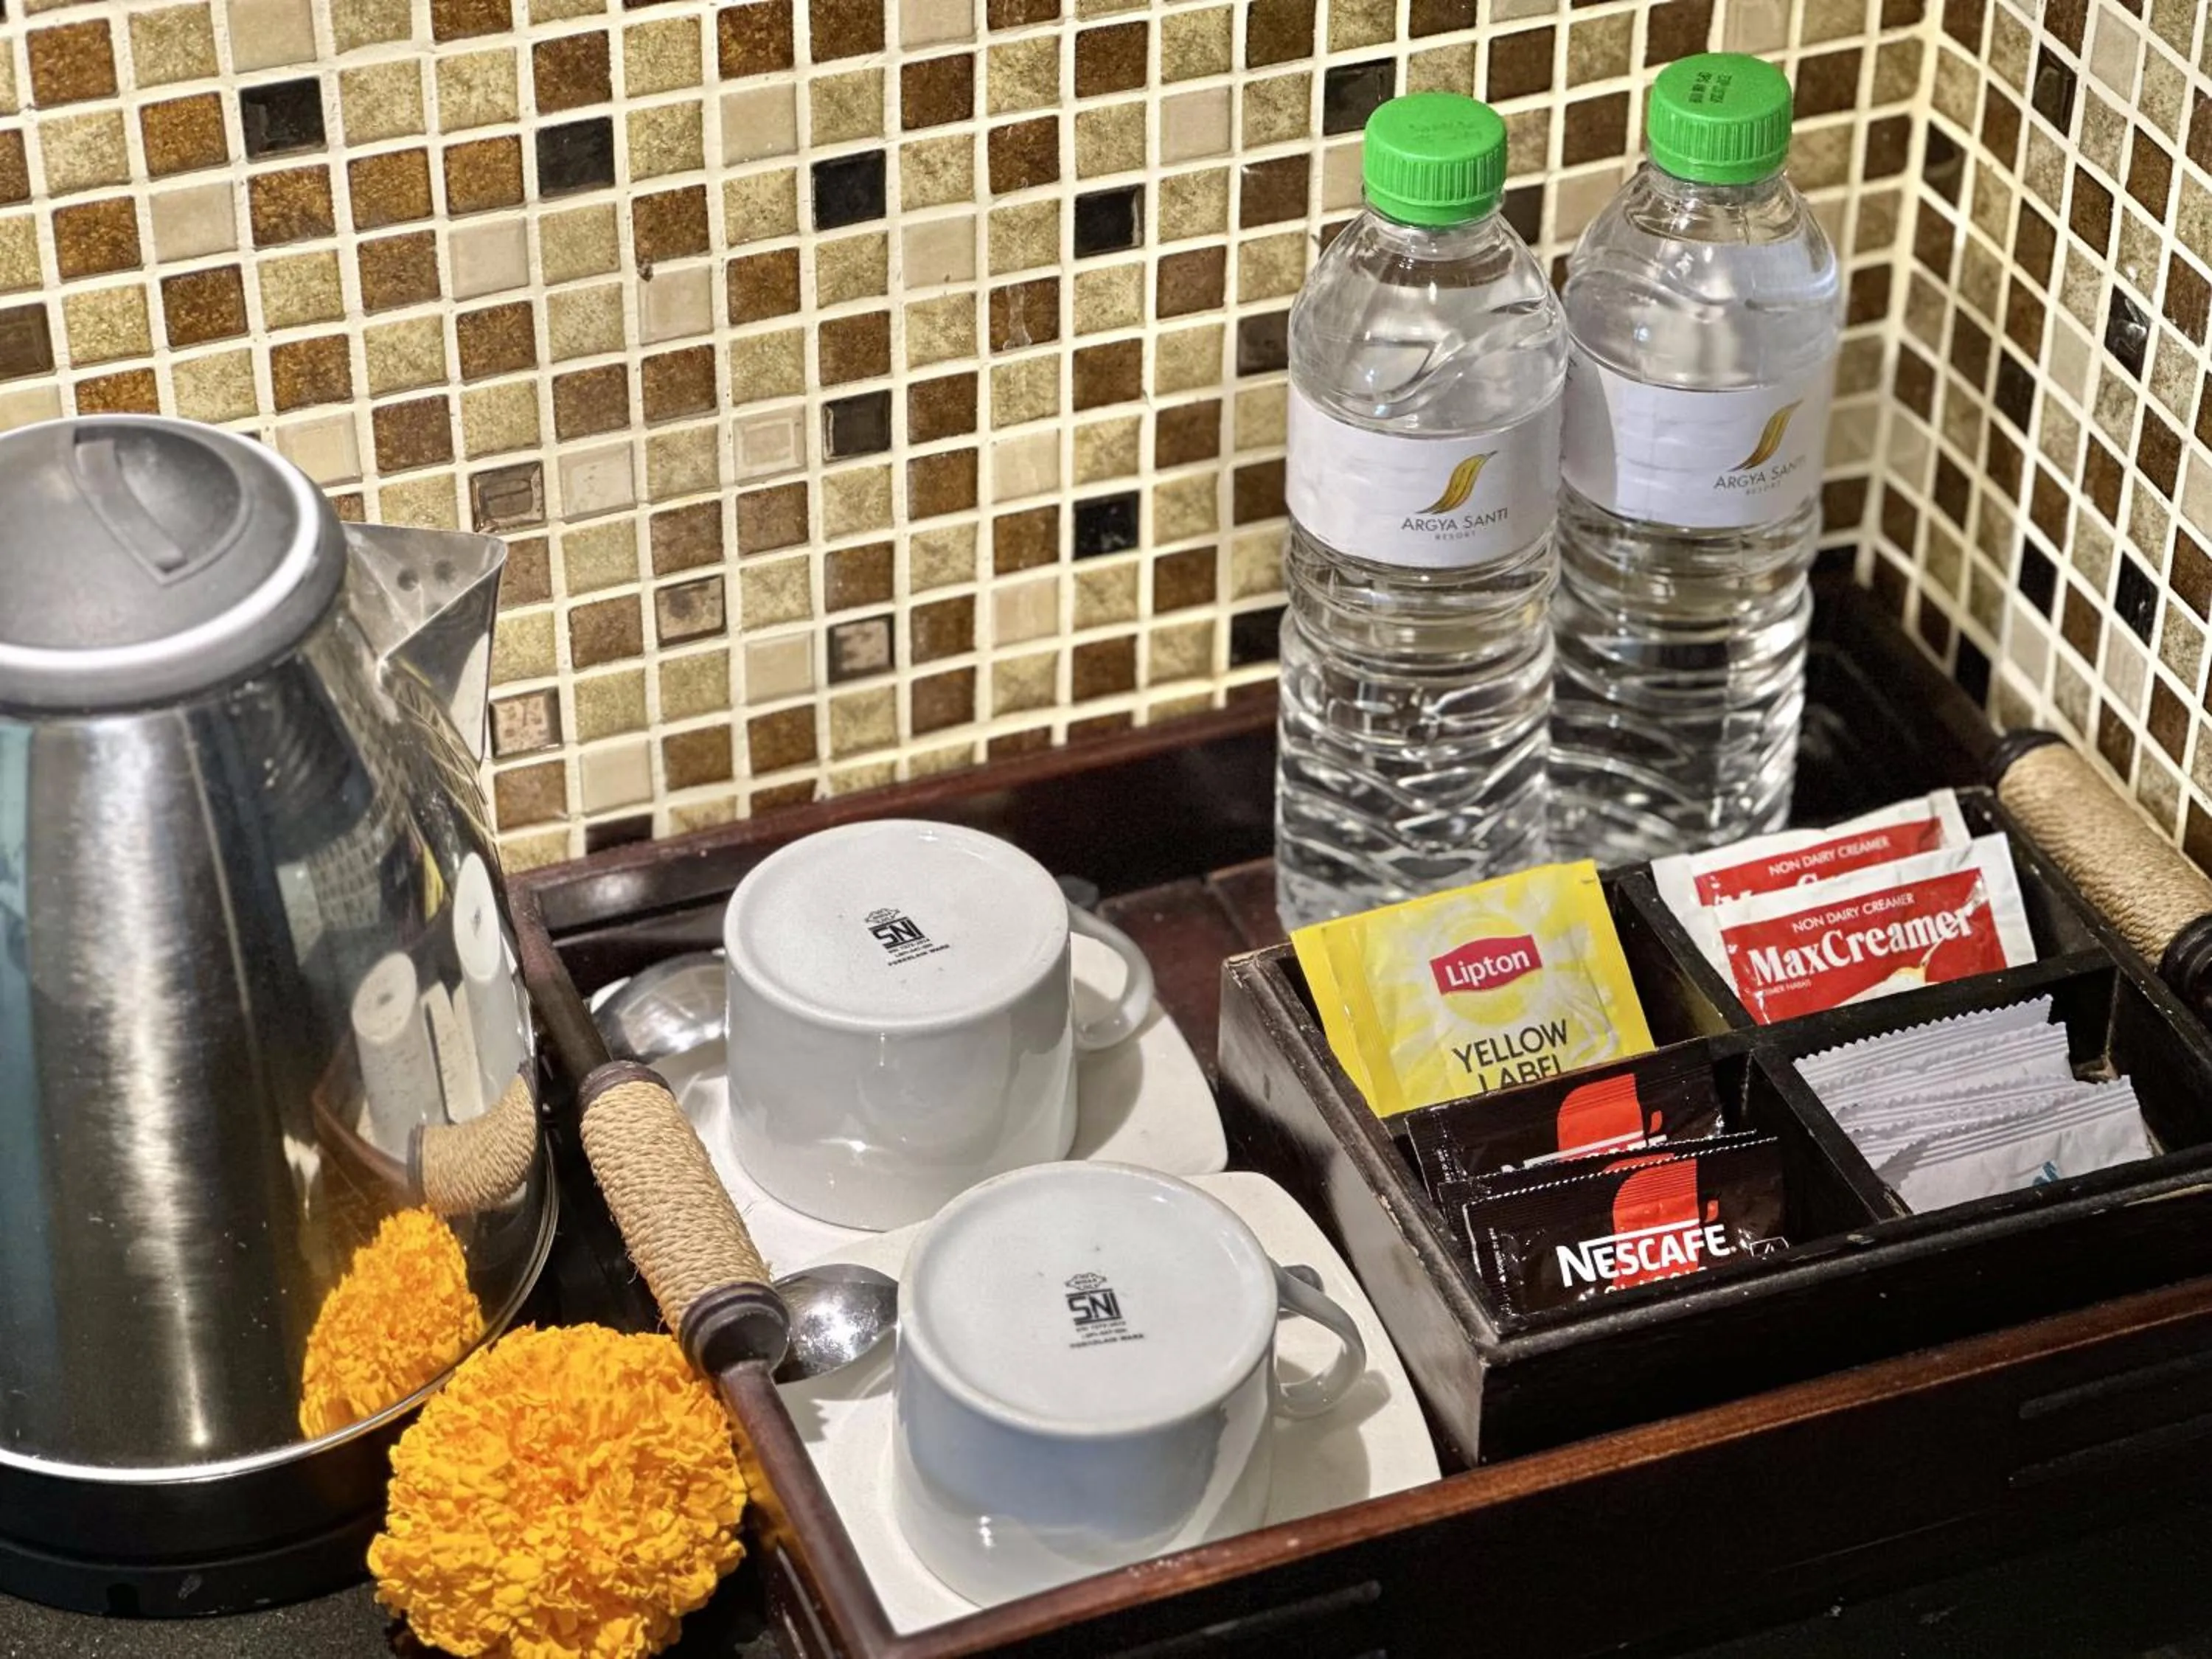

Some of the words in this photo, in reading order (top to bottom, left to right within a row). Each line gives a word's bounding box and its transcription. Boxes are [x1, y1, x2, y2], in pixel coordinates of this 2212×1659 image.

[1714, 471, 1765, 490] ARGYA
[1401, 518, 1458, 532] ARGYA
[1462, 507, 1509, 529] SANTI
[1768, 859, 1801, 876] NON
[1802, 849, 1836, 866] DAIRY
[1837, 835, 1891, 858] CREAMER
[1792, 916, 1825, 933] NON
[1826, 906, 1860, 925] DAIRY
[1862, 893, 1916, 915] CREAMER
[1747, 908, 1974, 987] MaxCreamer
[1445, 950, 1531, 987] Lipton
[1452, 1018, 1567, 1074] YELLOW
